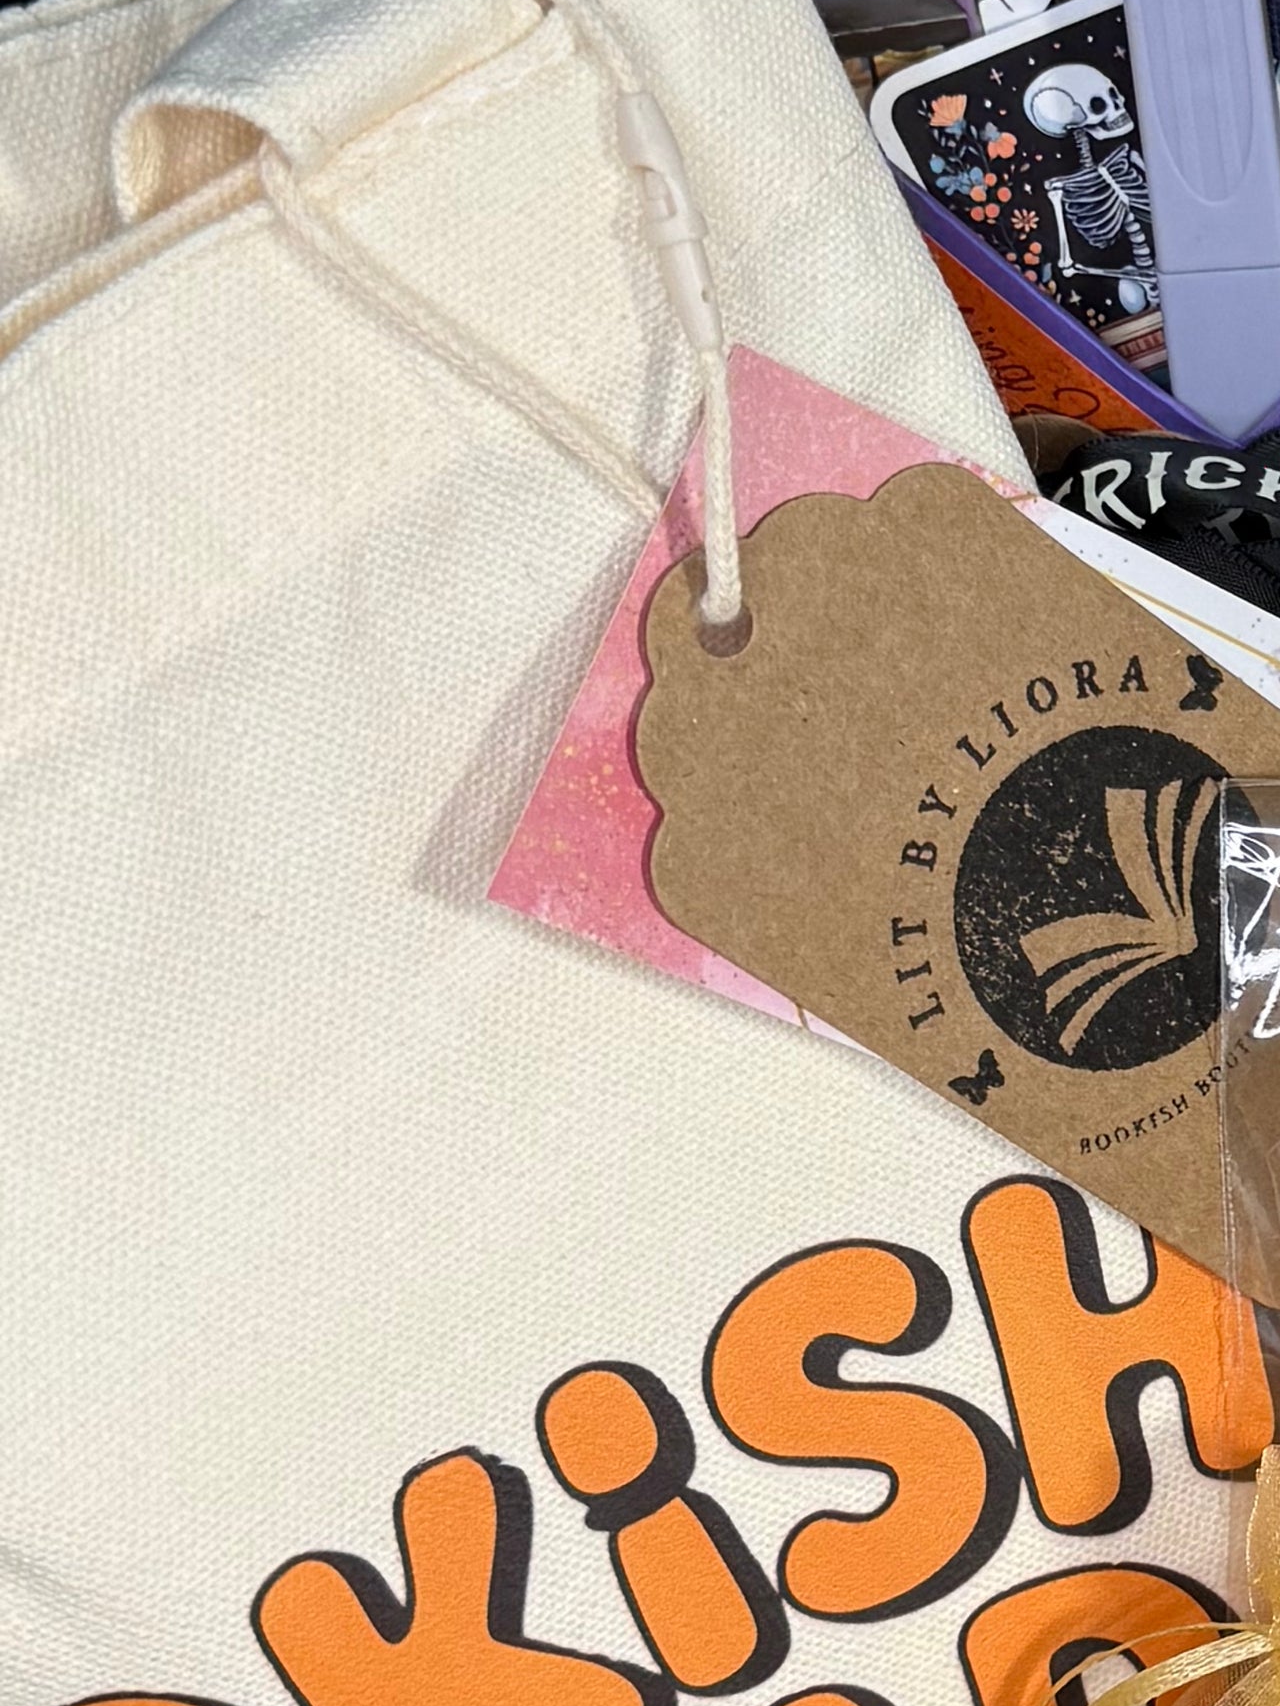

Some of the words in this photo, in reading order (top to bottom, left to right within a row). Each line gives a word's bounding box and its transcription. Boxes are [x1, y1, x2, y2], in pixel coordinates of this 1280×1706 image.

[955, 654, 1150, 772] LIORA
[898, 784, 959, 874] BY
[890, 915, 946, 1031] LIT
